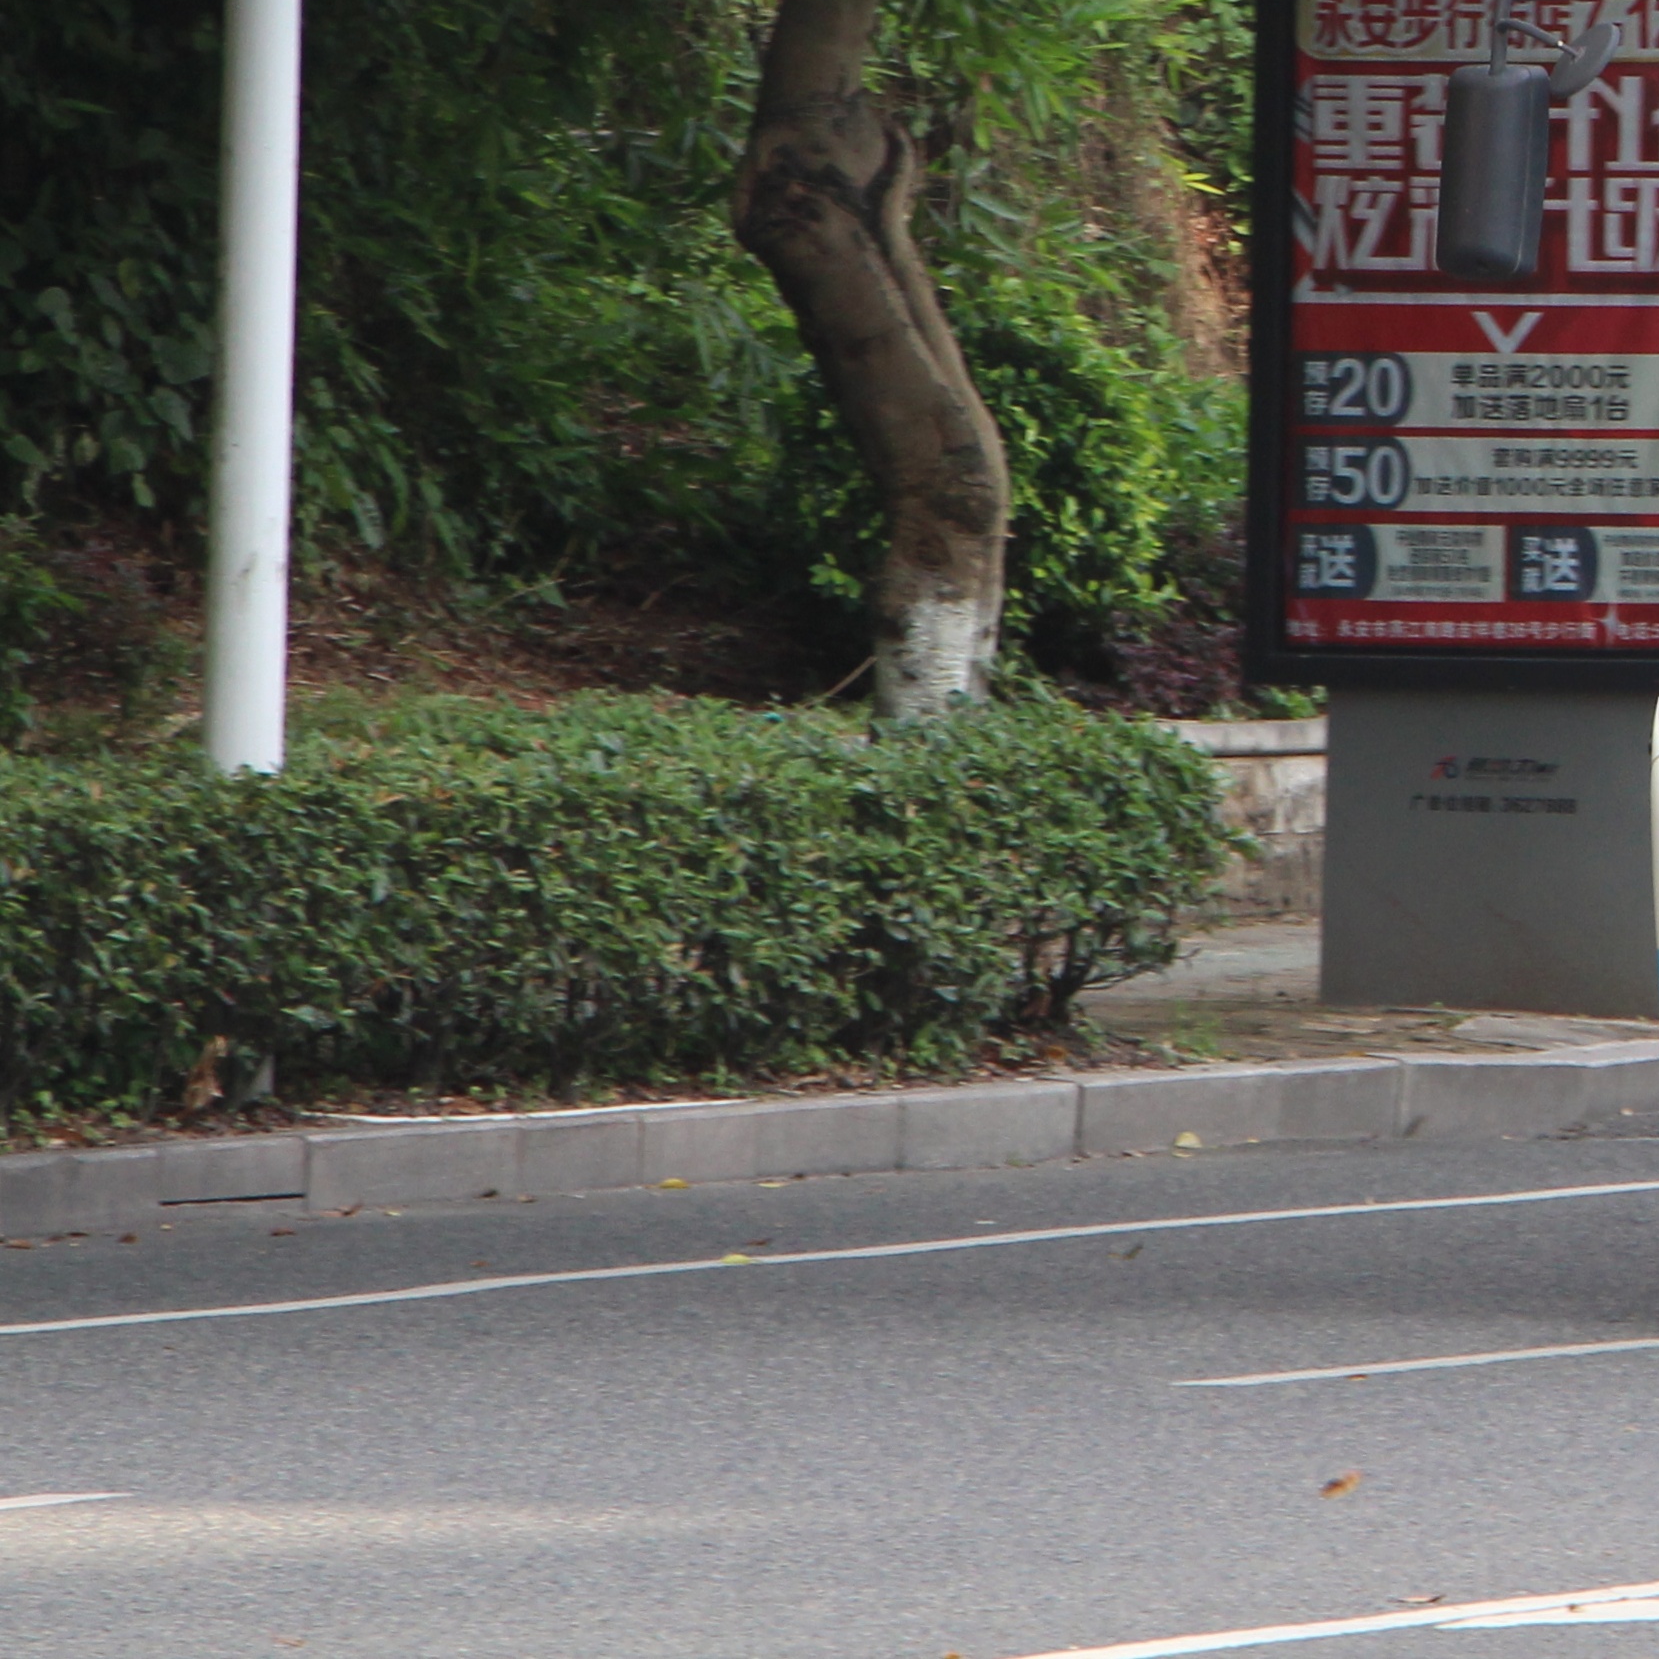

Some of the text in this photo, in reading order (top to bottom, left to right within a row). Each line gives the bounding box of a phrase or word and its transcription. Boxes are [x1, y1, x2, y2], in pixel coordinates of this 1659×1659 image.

[1329, 357, 1403, 418] 20
[1451, 363, 1631, 389] 单品满2000元
[1331, 445, 1404, 505] 50
